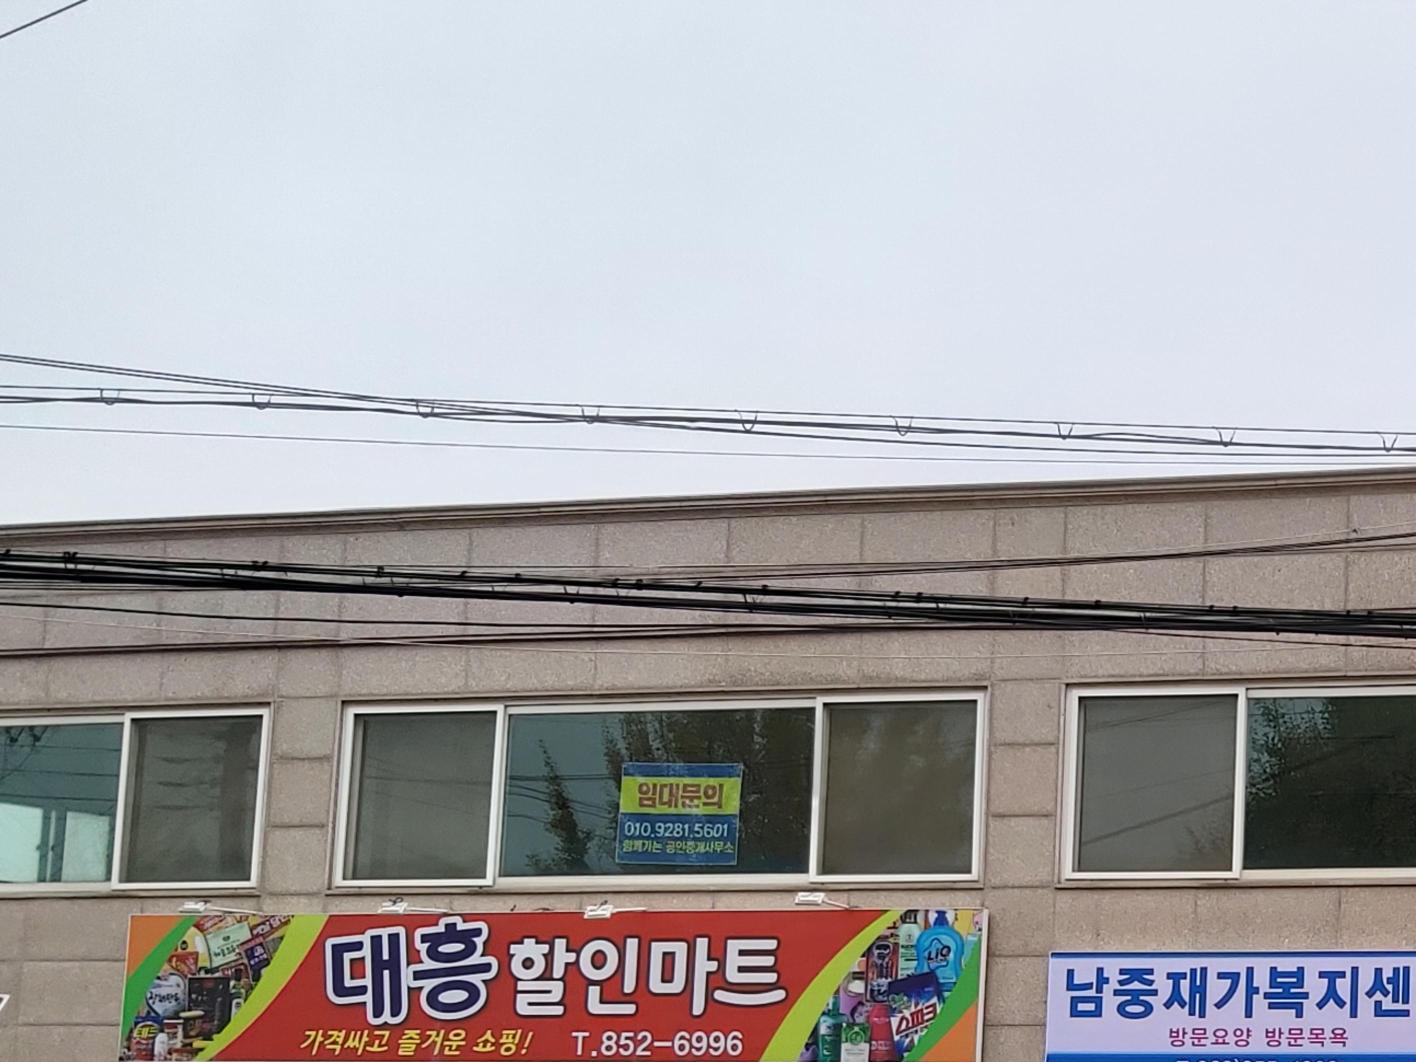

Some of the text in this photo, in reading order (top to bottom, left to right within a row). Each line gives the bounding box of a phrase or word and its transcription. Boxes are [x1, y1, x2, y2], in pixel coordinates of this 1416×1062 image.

[637, 782, 725, 809] 임대문의
[624, 821, 729, 838] 010.9281.5601
[326, 917, 787, 1024] 대흥 할인마트
[300, 1028, 534, 1057] 가격싸고 즐거운 쇼핑!
[571, 1030, 744, 1057] T.852-6996
[1168, 1027, 1349, 1048] 방문요양 방문목욕
